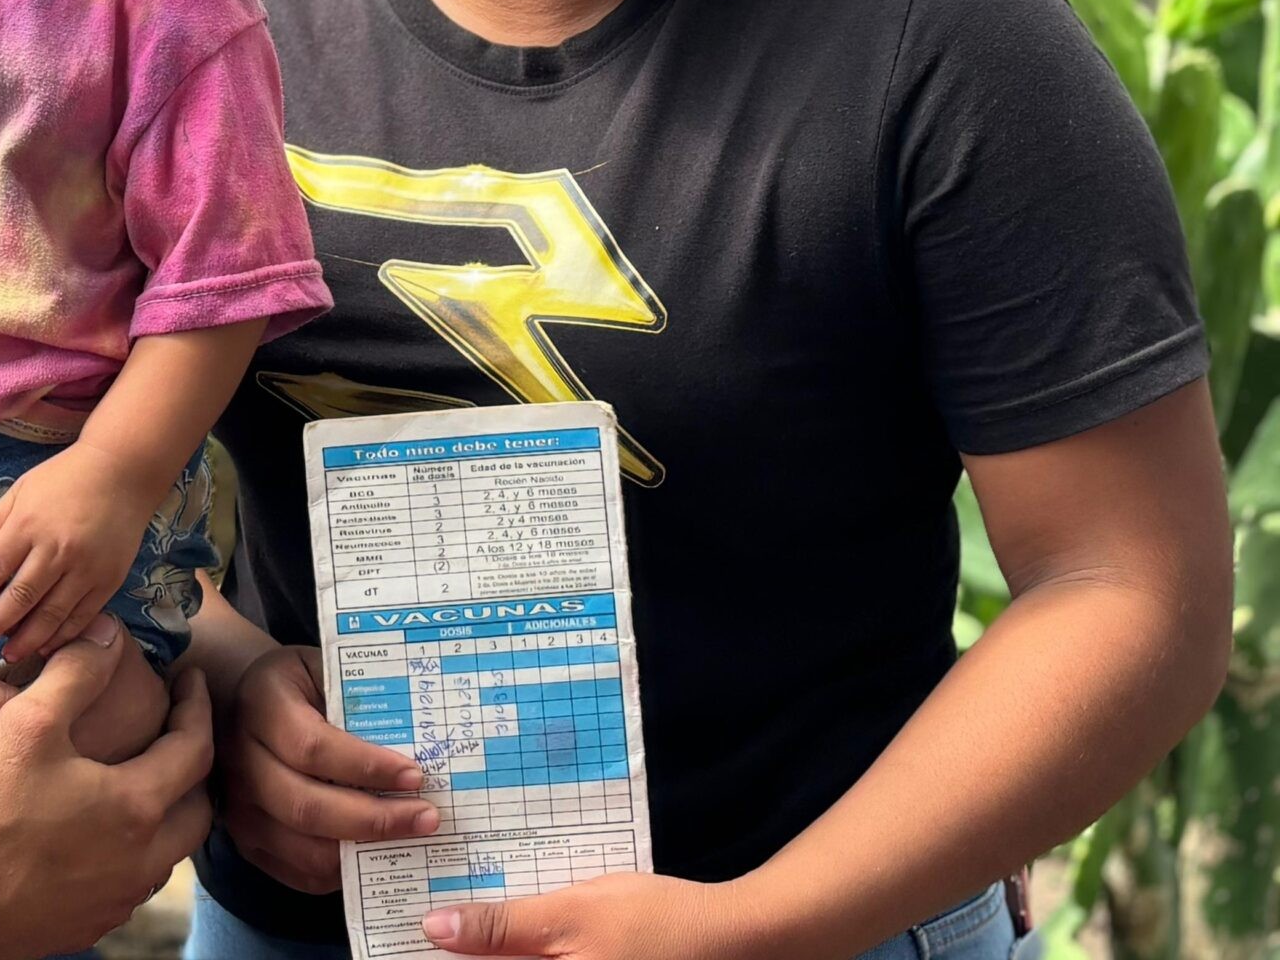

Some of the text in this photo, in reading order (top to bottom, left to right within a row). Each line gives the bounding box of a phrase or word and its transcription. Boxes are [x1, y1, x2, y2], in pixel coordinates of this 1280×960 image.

[353, 444, 399, 460] Todo
[452, 441, 497, 454] debe
[504, 437, 560, 450] tener:
[470, 464, 496, 472] Edad
[515, 461, 523, 469] la
[526, 457, 586, 468] vacunación
[432, 483, 438, 494] 1
[433, 496, 441, 506] 3
[435, 509, 442, 519] 3
[497, 516, 505, 526] 2
[517, 515, 525, 524] 4
[435, 522, 443, 532] 2
[437, 535, 445, 545] 3
[476, 545, 485, 554] A
[488, 544, 505, 553] los
[510, 542, 523, 552] 12
[540, 540, 552, 550] 18
[438, 548, 446, 558] 2
[433, 561, 451, 574] (2)
[365, 587, 379, 596] dT
[441, 583, 449, 593] 2
[372, 599, 586, 627] VACUNAS
[524, 617, 597, 631] ADICIONALES
[440, 626, 472, 637] DOSIS
[420, 645, 426, 655] 1
[454, 643, 461, 653] 2
[490, 640, 497, 650] 3
[548, 636, 555, 646] 2
[577, 634, 583, 644] 3
[600, 632, 607, 641] 4
[346, 649, 389, 658] VACUNAS
